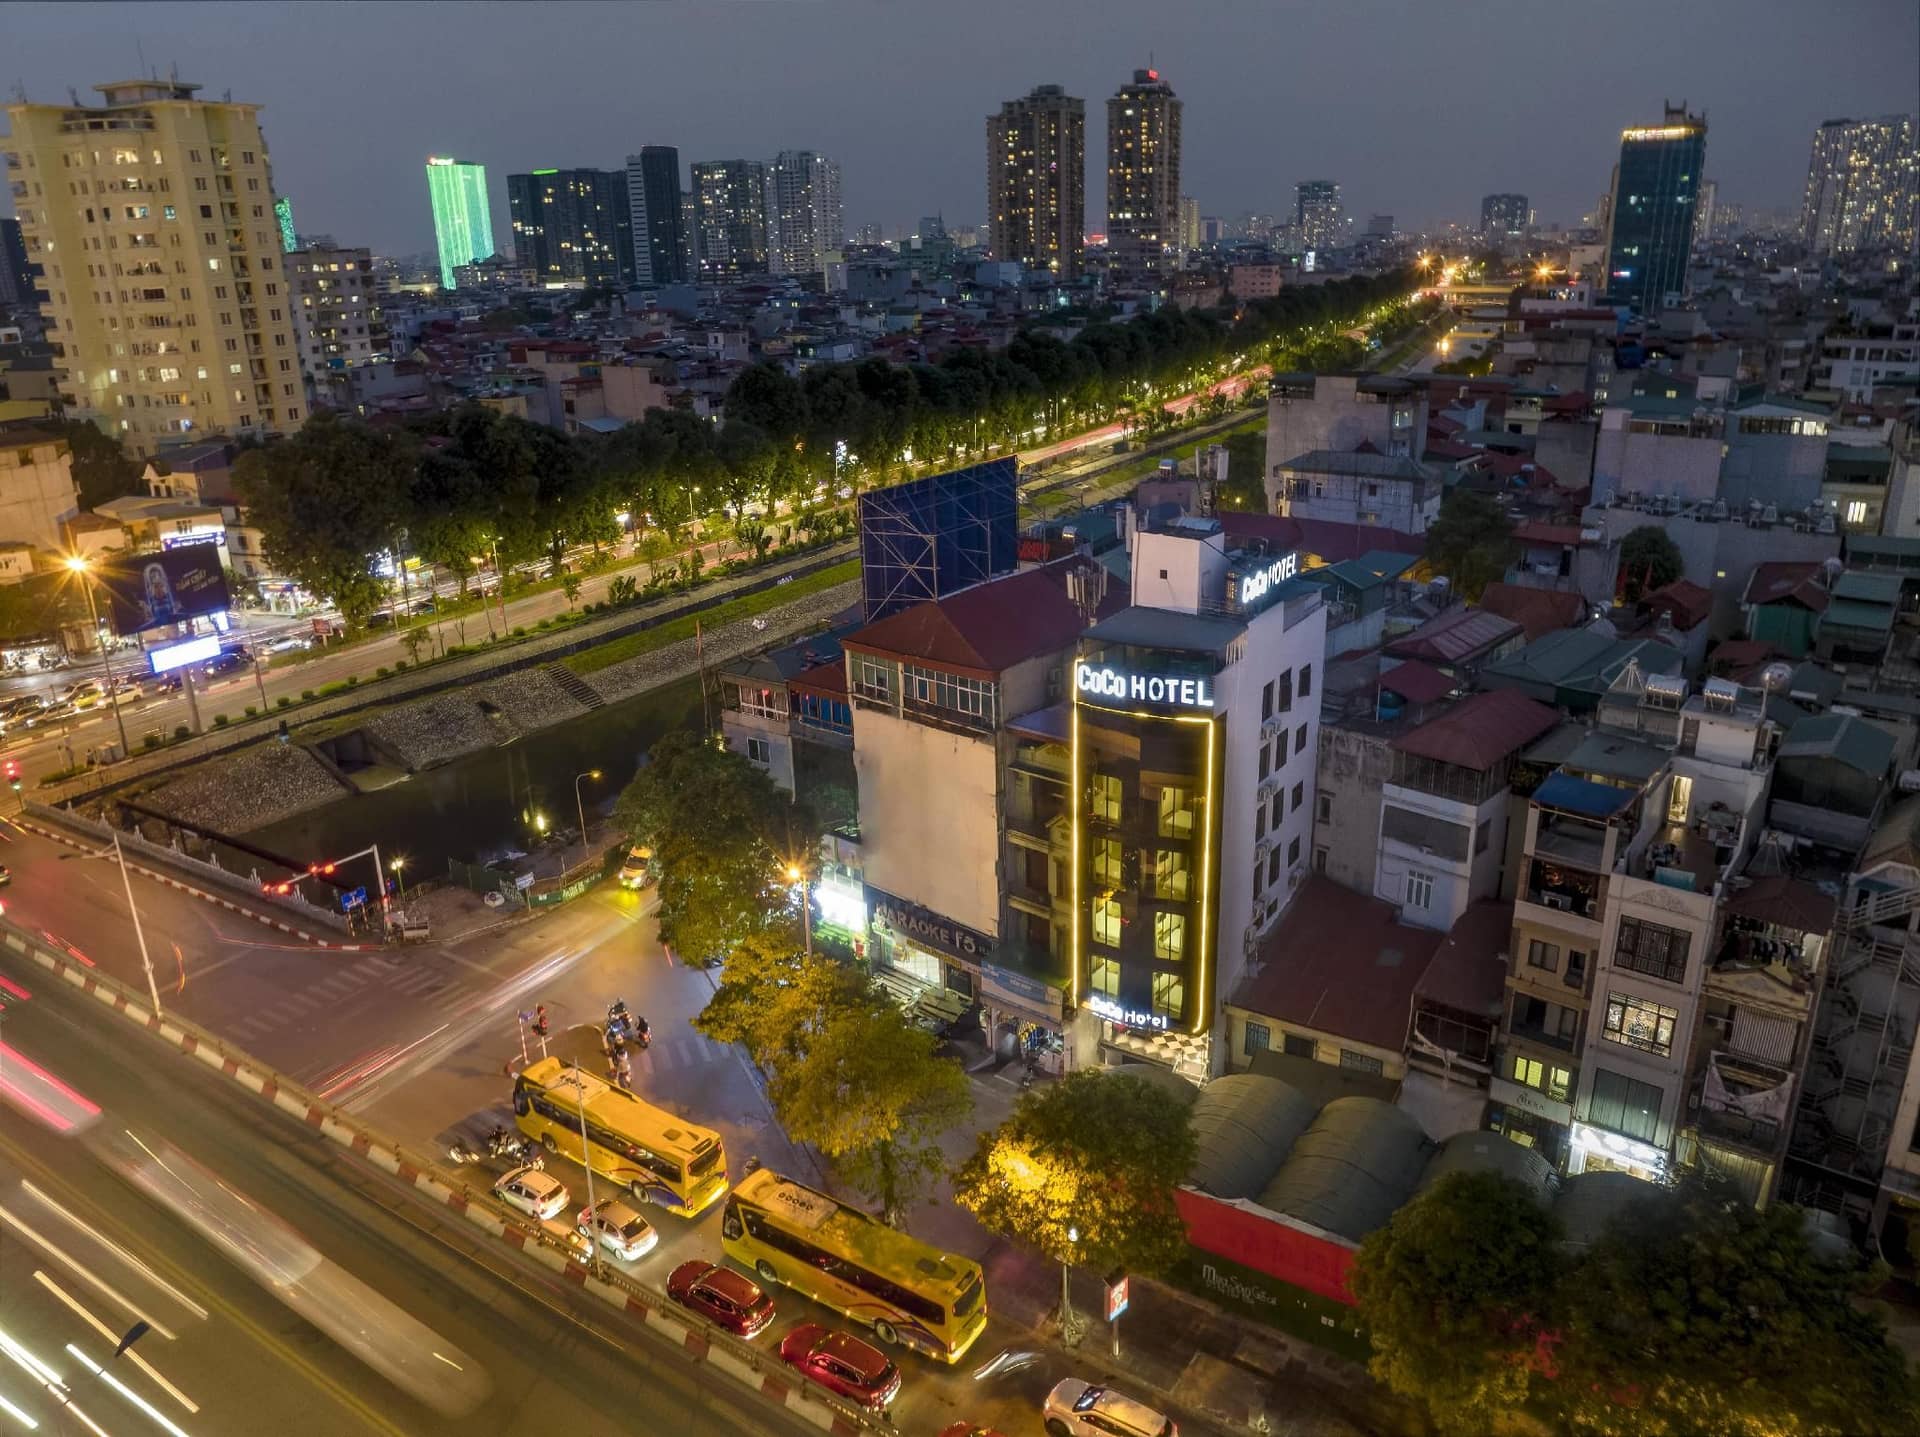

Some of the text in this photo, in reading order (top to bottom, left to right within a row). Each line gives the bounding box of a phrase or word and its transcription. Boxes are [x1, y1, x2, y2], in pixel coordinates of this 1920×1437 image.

[1268, 553, 1296, 587] HOTEL
[1077, 664, 1214, 707] CoCo HOTEL
